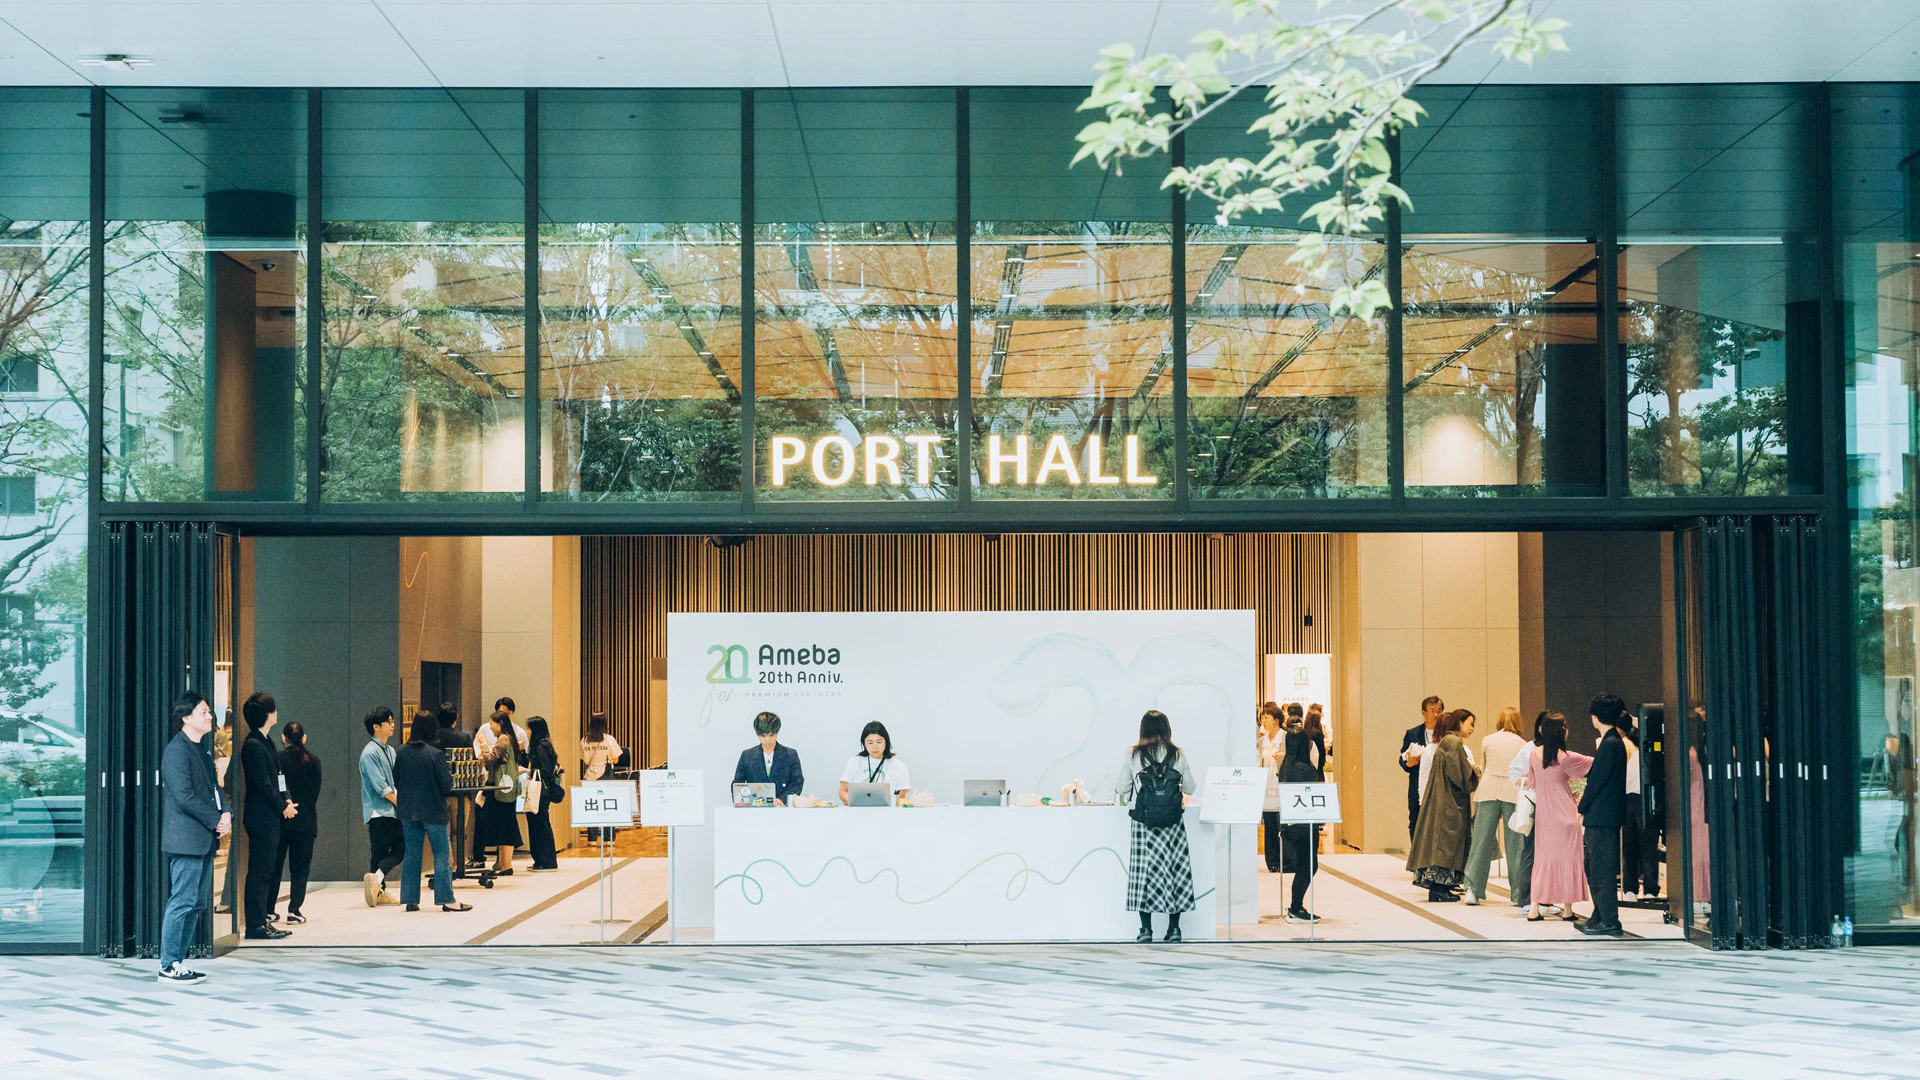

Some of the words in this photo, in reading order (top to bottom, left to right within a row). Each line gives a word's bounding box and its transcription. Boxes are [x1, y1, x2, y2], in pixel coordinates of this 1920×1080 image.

[771, 435, 942, 486] PORT
[988, 434, 1158, 485] HALL
[758, 643, 841, 666] Ameba
[758, 671, 793, 684] 20th
[797, 670, 844, 684] Anniv.
[584, 797, 618, 812] 出口
[1292, 794, 1326, 808] 入口
